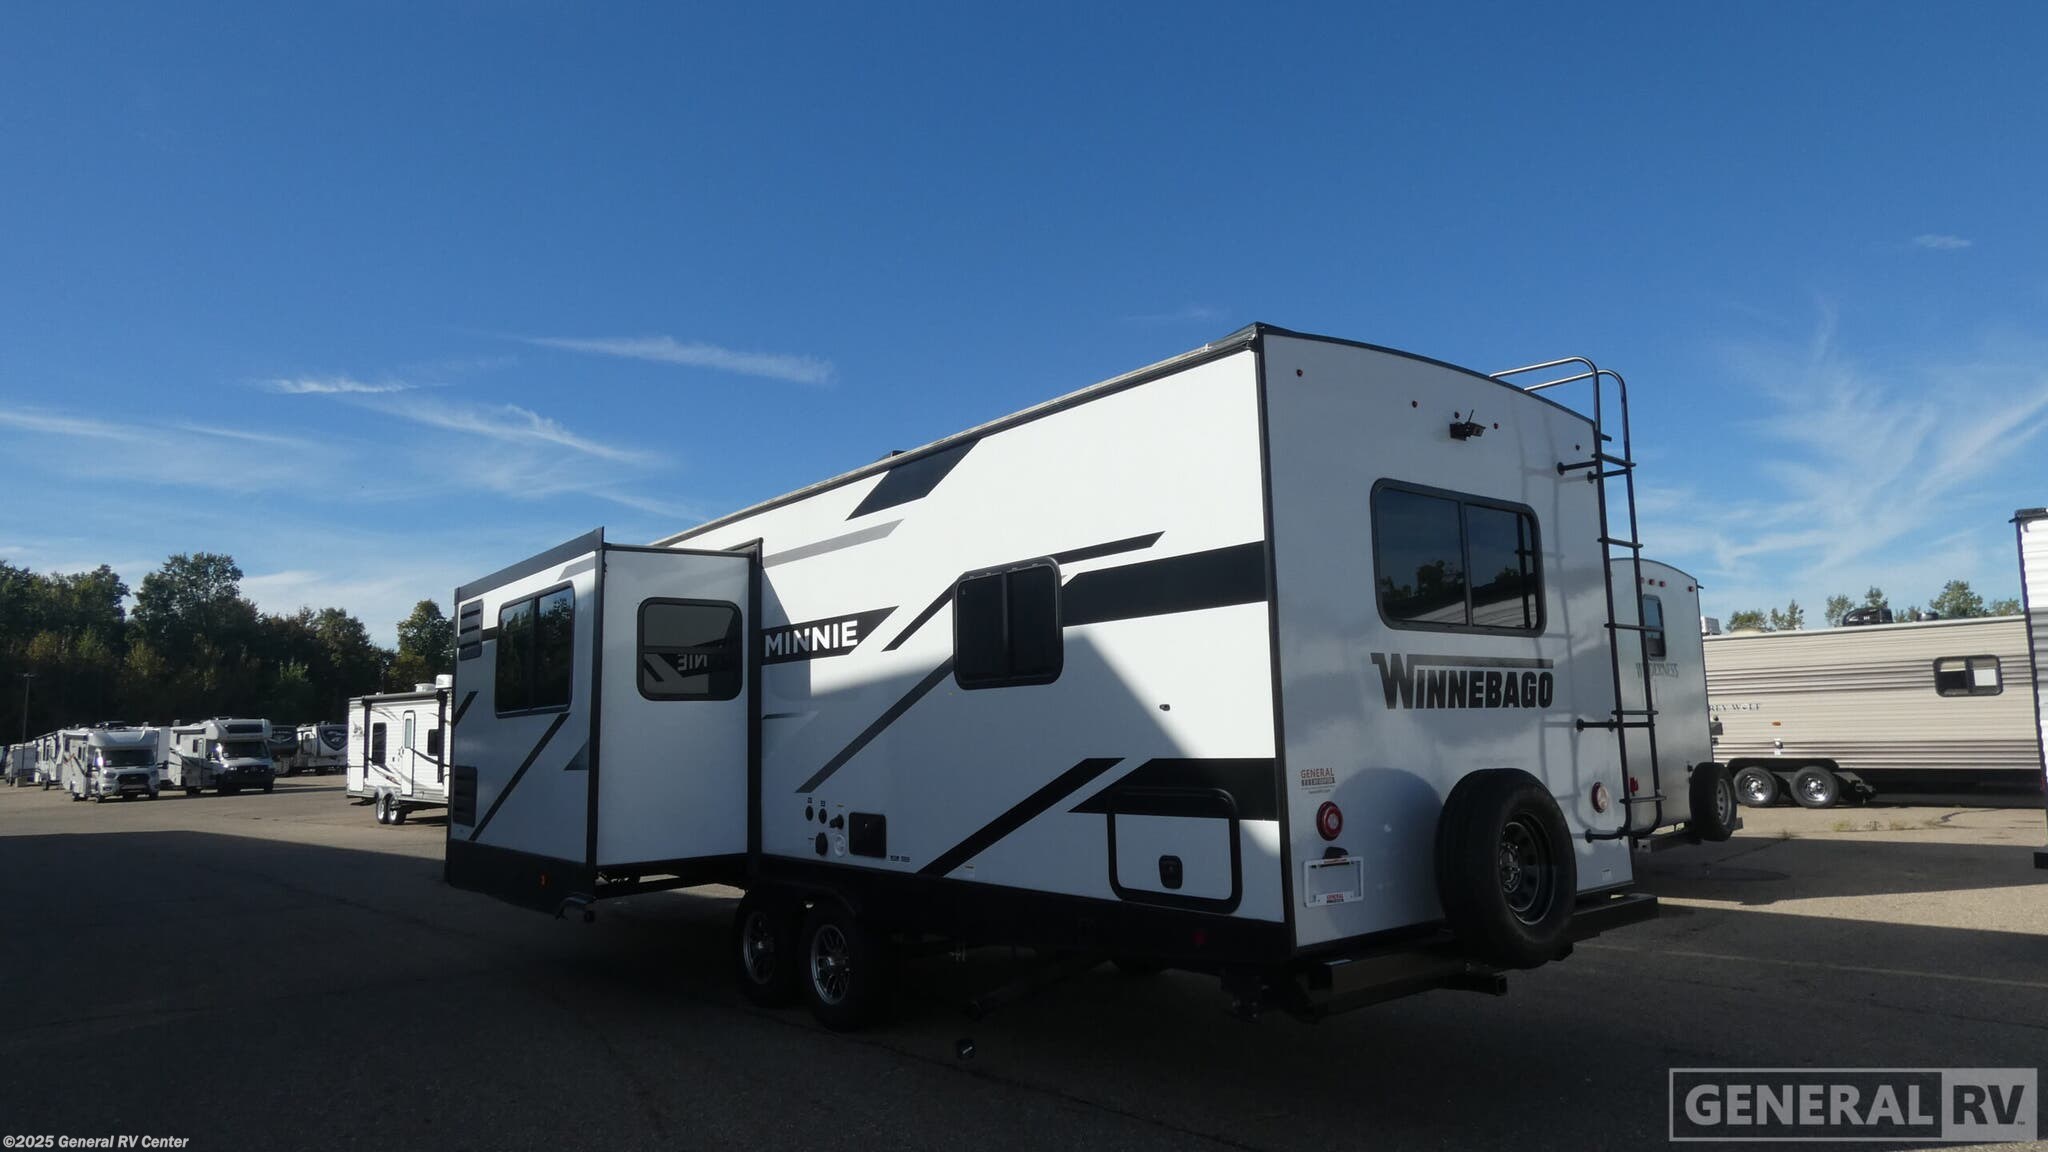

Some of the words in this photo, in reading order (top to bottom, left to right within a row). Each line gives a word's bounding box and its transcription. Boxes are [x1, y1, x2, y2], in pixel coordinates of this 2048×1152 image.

[764, 619, 858, 658] MINNIE
[1370, 652, 1554, 710] WINNEBAGO
[1301, 768, 1335, 778] GENERAL
